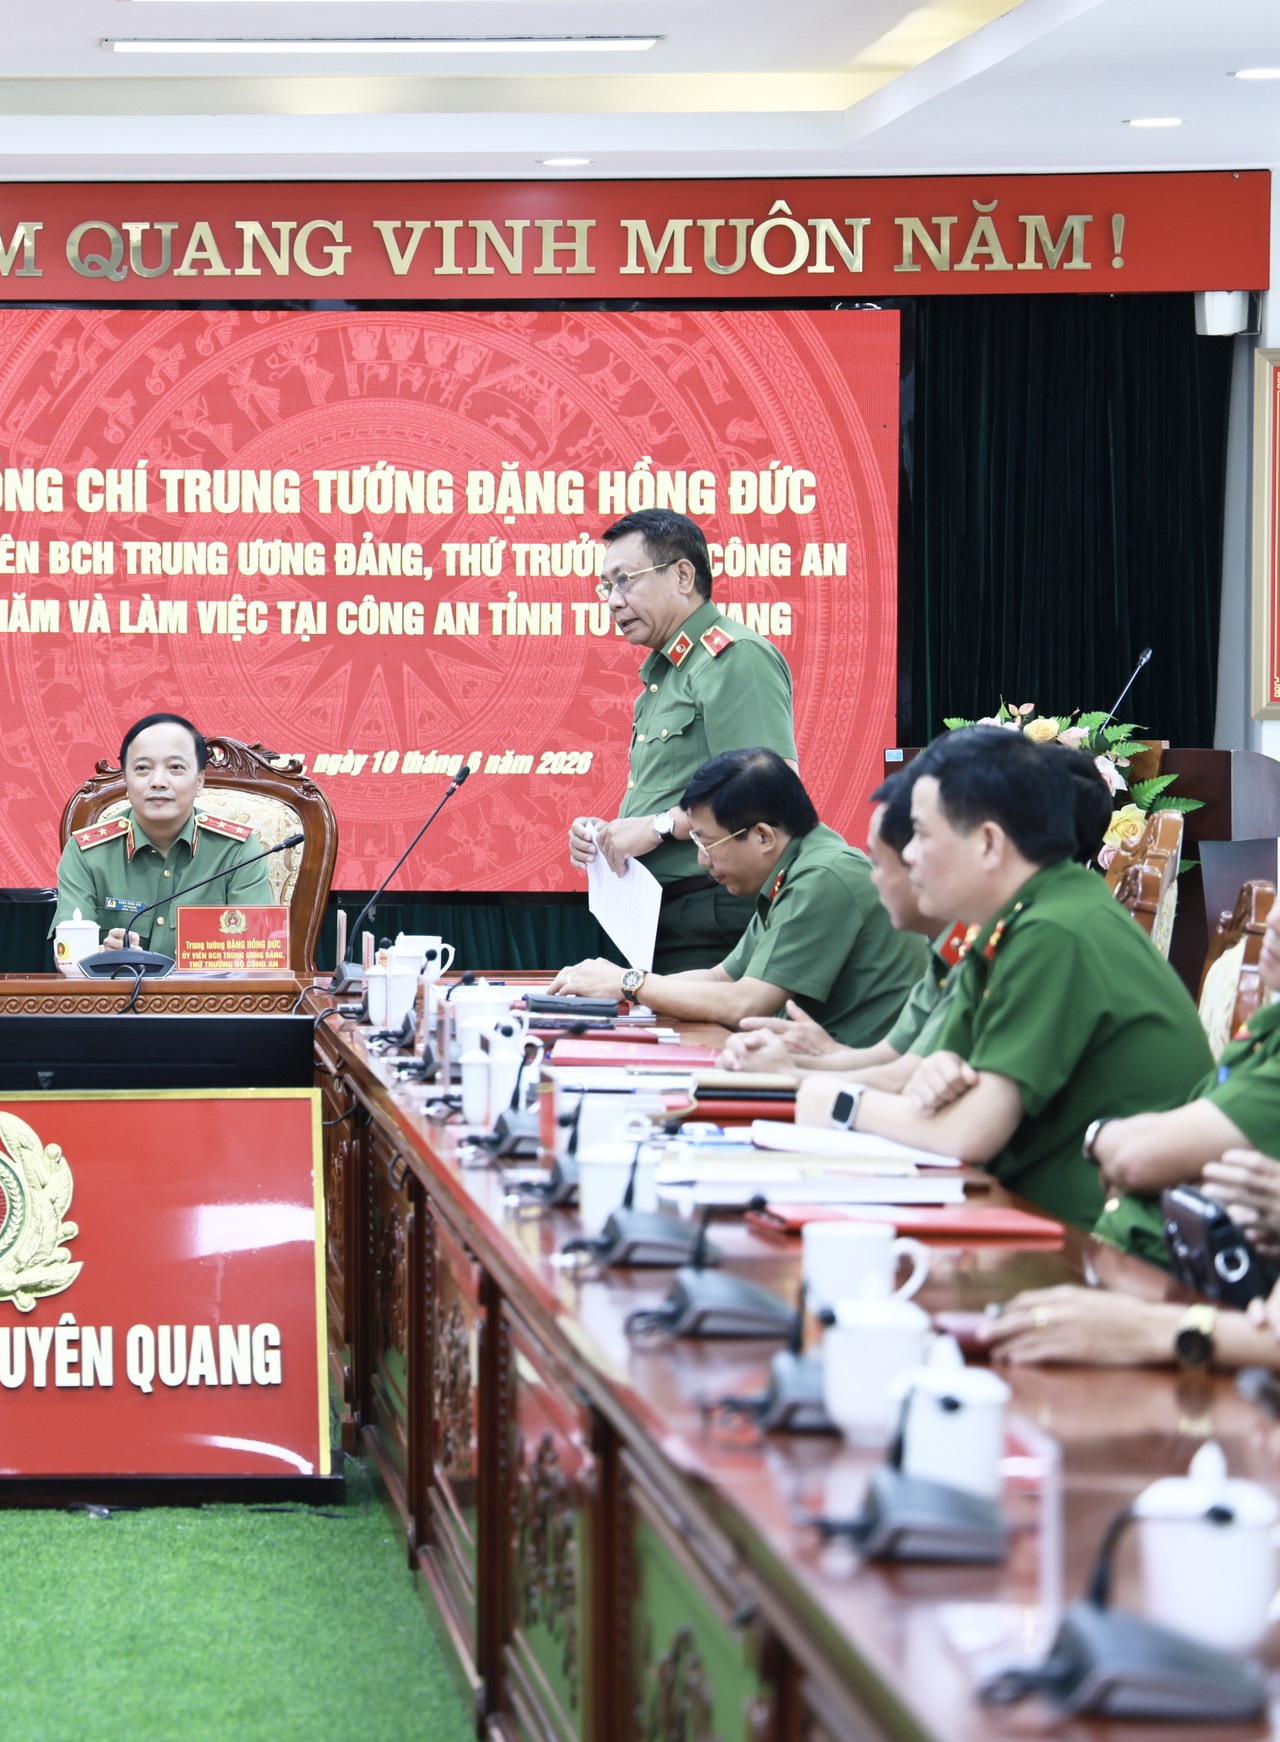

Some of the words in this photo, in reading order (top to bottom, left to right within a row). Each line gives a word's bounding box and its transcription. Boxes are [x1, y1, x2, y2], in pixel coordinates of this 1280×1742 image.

[66, 220, 352, 282] QUANG
[373, 219, 596, 275] VINH
[619, 200, 871, 275] MUÔN
[894, 199, 1093, 272] NĂM
[76, 460, 148, 513] CHÍ
[160, 469, 300, 514] TRUNG
[313, 461, 454, 515] TƯỚNG
[466, 461, 585, 524] ĐẶNG
[598, 456, 716, 515] HỒNG
[728, 461, 817, 515] ĐỨC
[49, 541, 114, 575] BCH
[123, 541, 228, 576] TRUNG
[238, 539, 326, 576] ƯƠNG
[334, 532, 433, 580] ĐẢNG,
[441, 536, 507, 577] THỨ
[511, 532, 608, 577] TRƯỞ
[707, 537, 791, 577] CÔNG
[801, 543, 847, 577] AN
[69, 593, 110, 634] VÀ
[120, 594, 187, 634] LÀM
[197, 594, 268, 642] VIỆC
[277, 601, 327, 642] TẠI
[337, 595, 424, 636] CÔNG
[434, 602, 480, 636] AN
[488, 591, 562, 636] TỈNH
[313, 750, 369, 776] ngày
[371, 751, 400, 774] 10
[401, 750, 465, 777] tháng
[466, 752, 483, 774] 6
[484, 750, 534, 774] năm
[536, 751, 594, 775] 2026
[186, 941, 205, 951] Trung
[126, 1322, 281, 1393] QUANG
